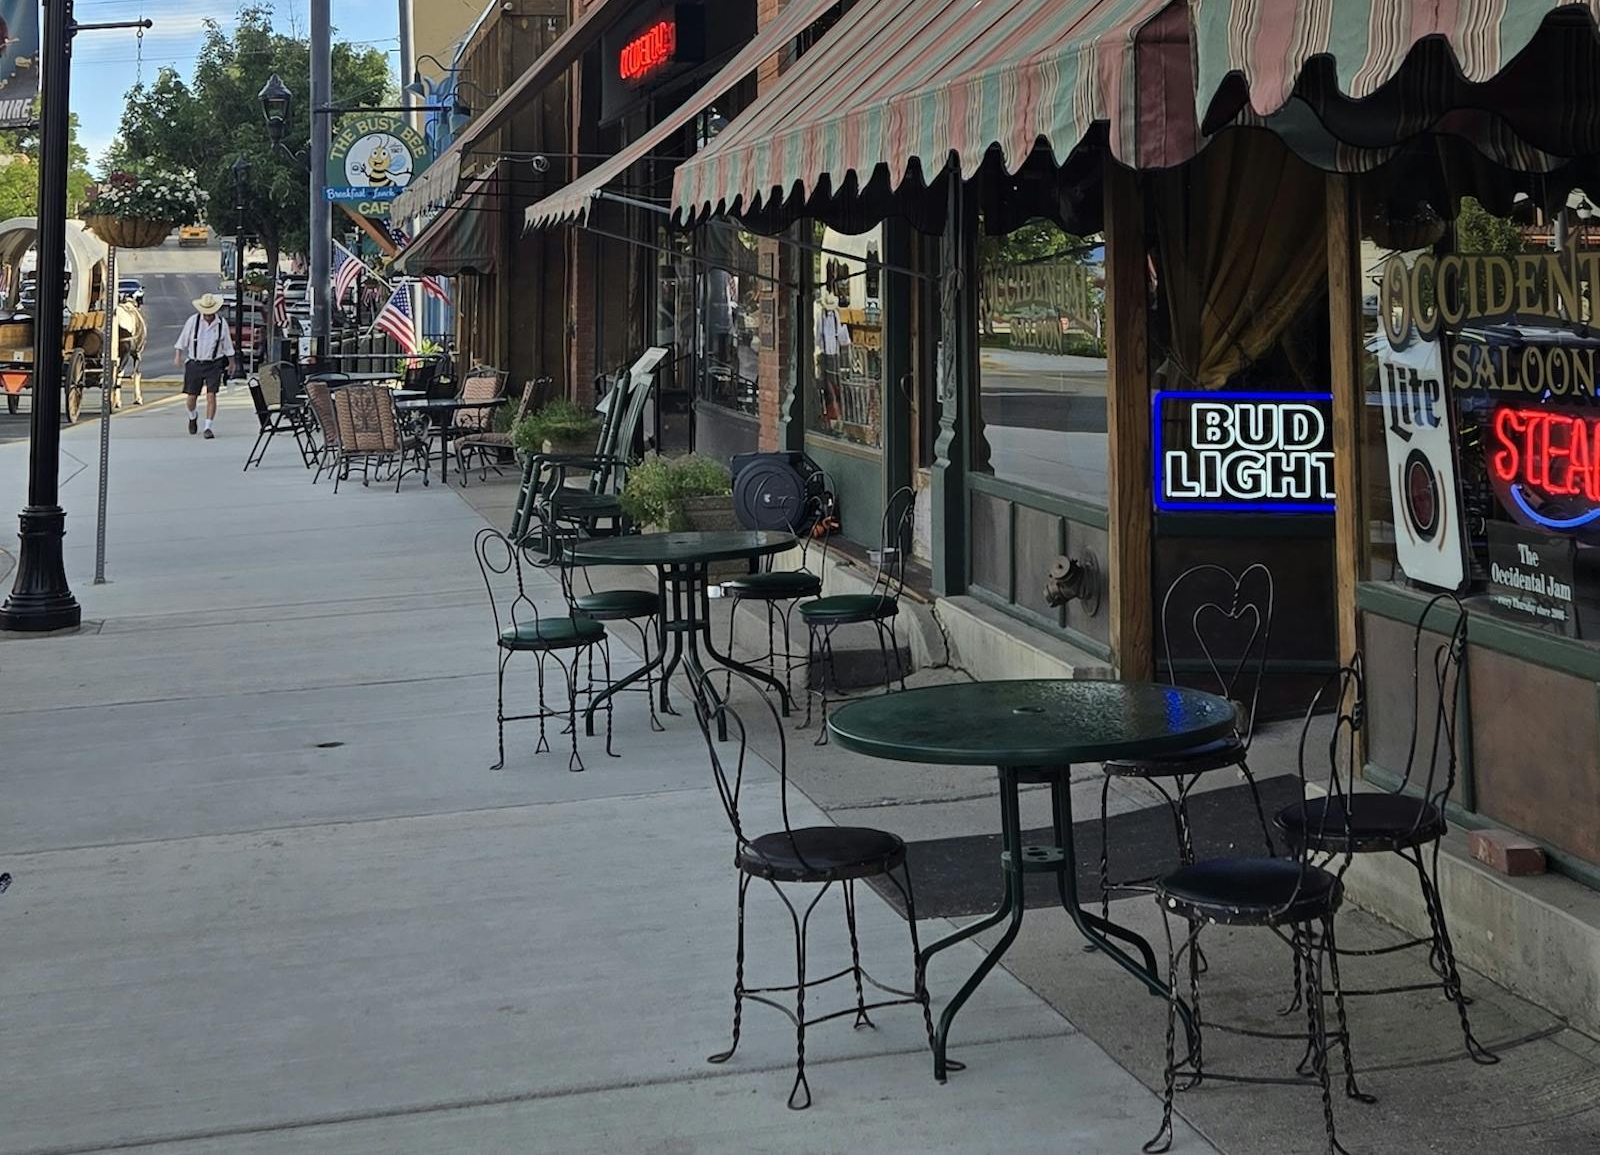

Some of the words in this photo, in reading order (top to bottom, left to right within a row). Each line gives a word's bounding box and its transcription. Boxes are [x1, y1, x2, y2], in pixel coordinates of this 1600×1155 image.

[330, 128, 356, 160] THE
[355, 117, 402, 134] BUSY
[400, 126, 427, 159] BEE
[358, 201, 391, 215] CAF
[1009, 317, 1063, 353] SALOON
[1452, 343, 1597, 397] SALOON
[1191, 402, 1325, 451] BUD
[1494, 407, 1600, 502] STEA
[1517, 543, 1540, 566] The
[1491, 562, 1546, 595] Occidental
[1546, 576, 1572, 601] Jam
